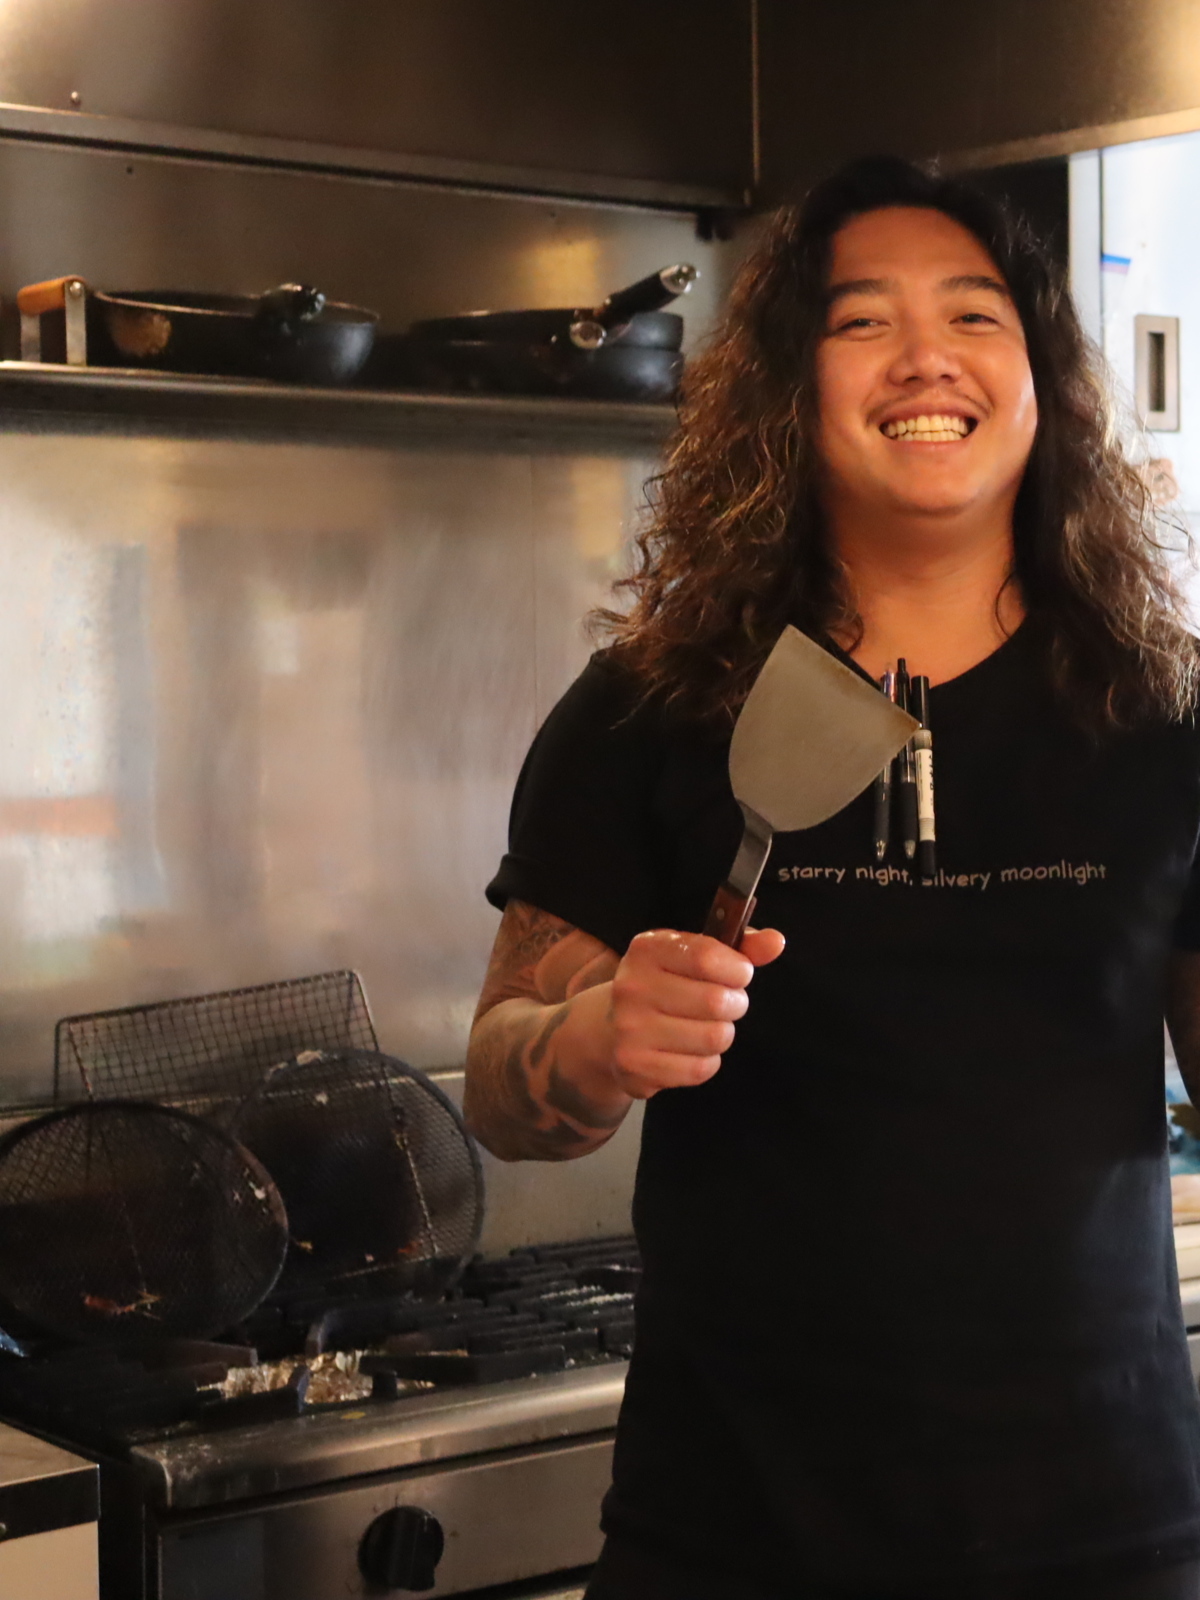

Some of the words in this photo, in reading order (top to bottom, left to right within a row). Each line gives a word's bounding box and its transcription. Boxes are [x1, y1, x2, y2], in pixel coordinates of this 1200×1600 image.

[778, 866, 846, 884] starry
[856, 865, 913, 887] night,
[1001, 859, 1107, 886] moonlight
